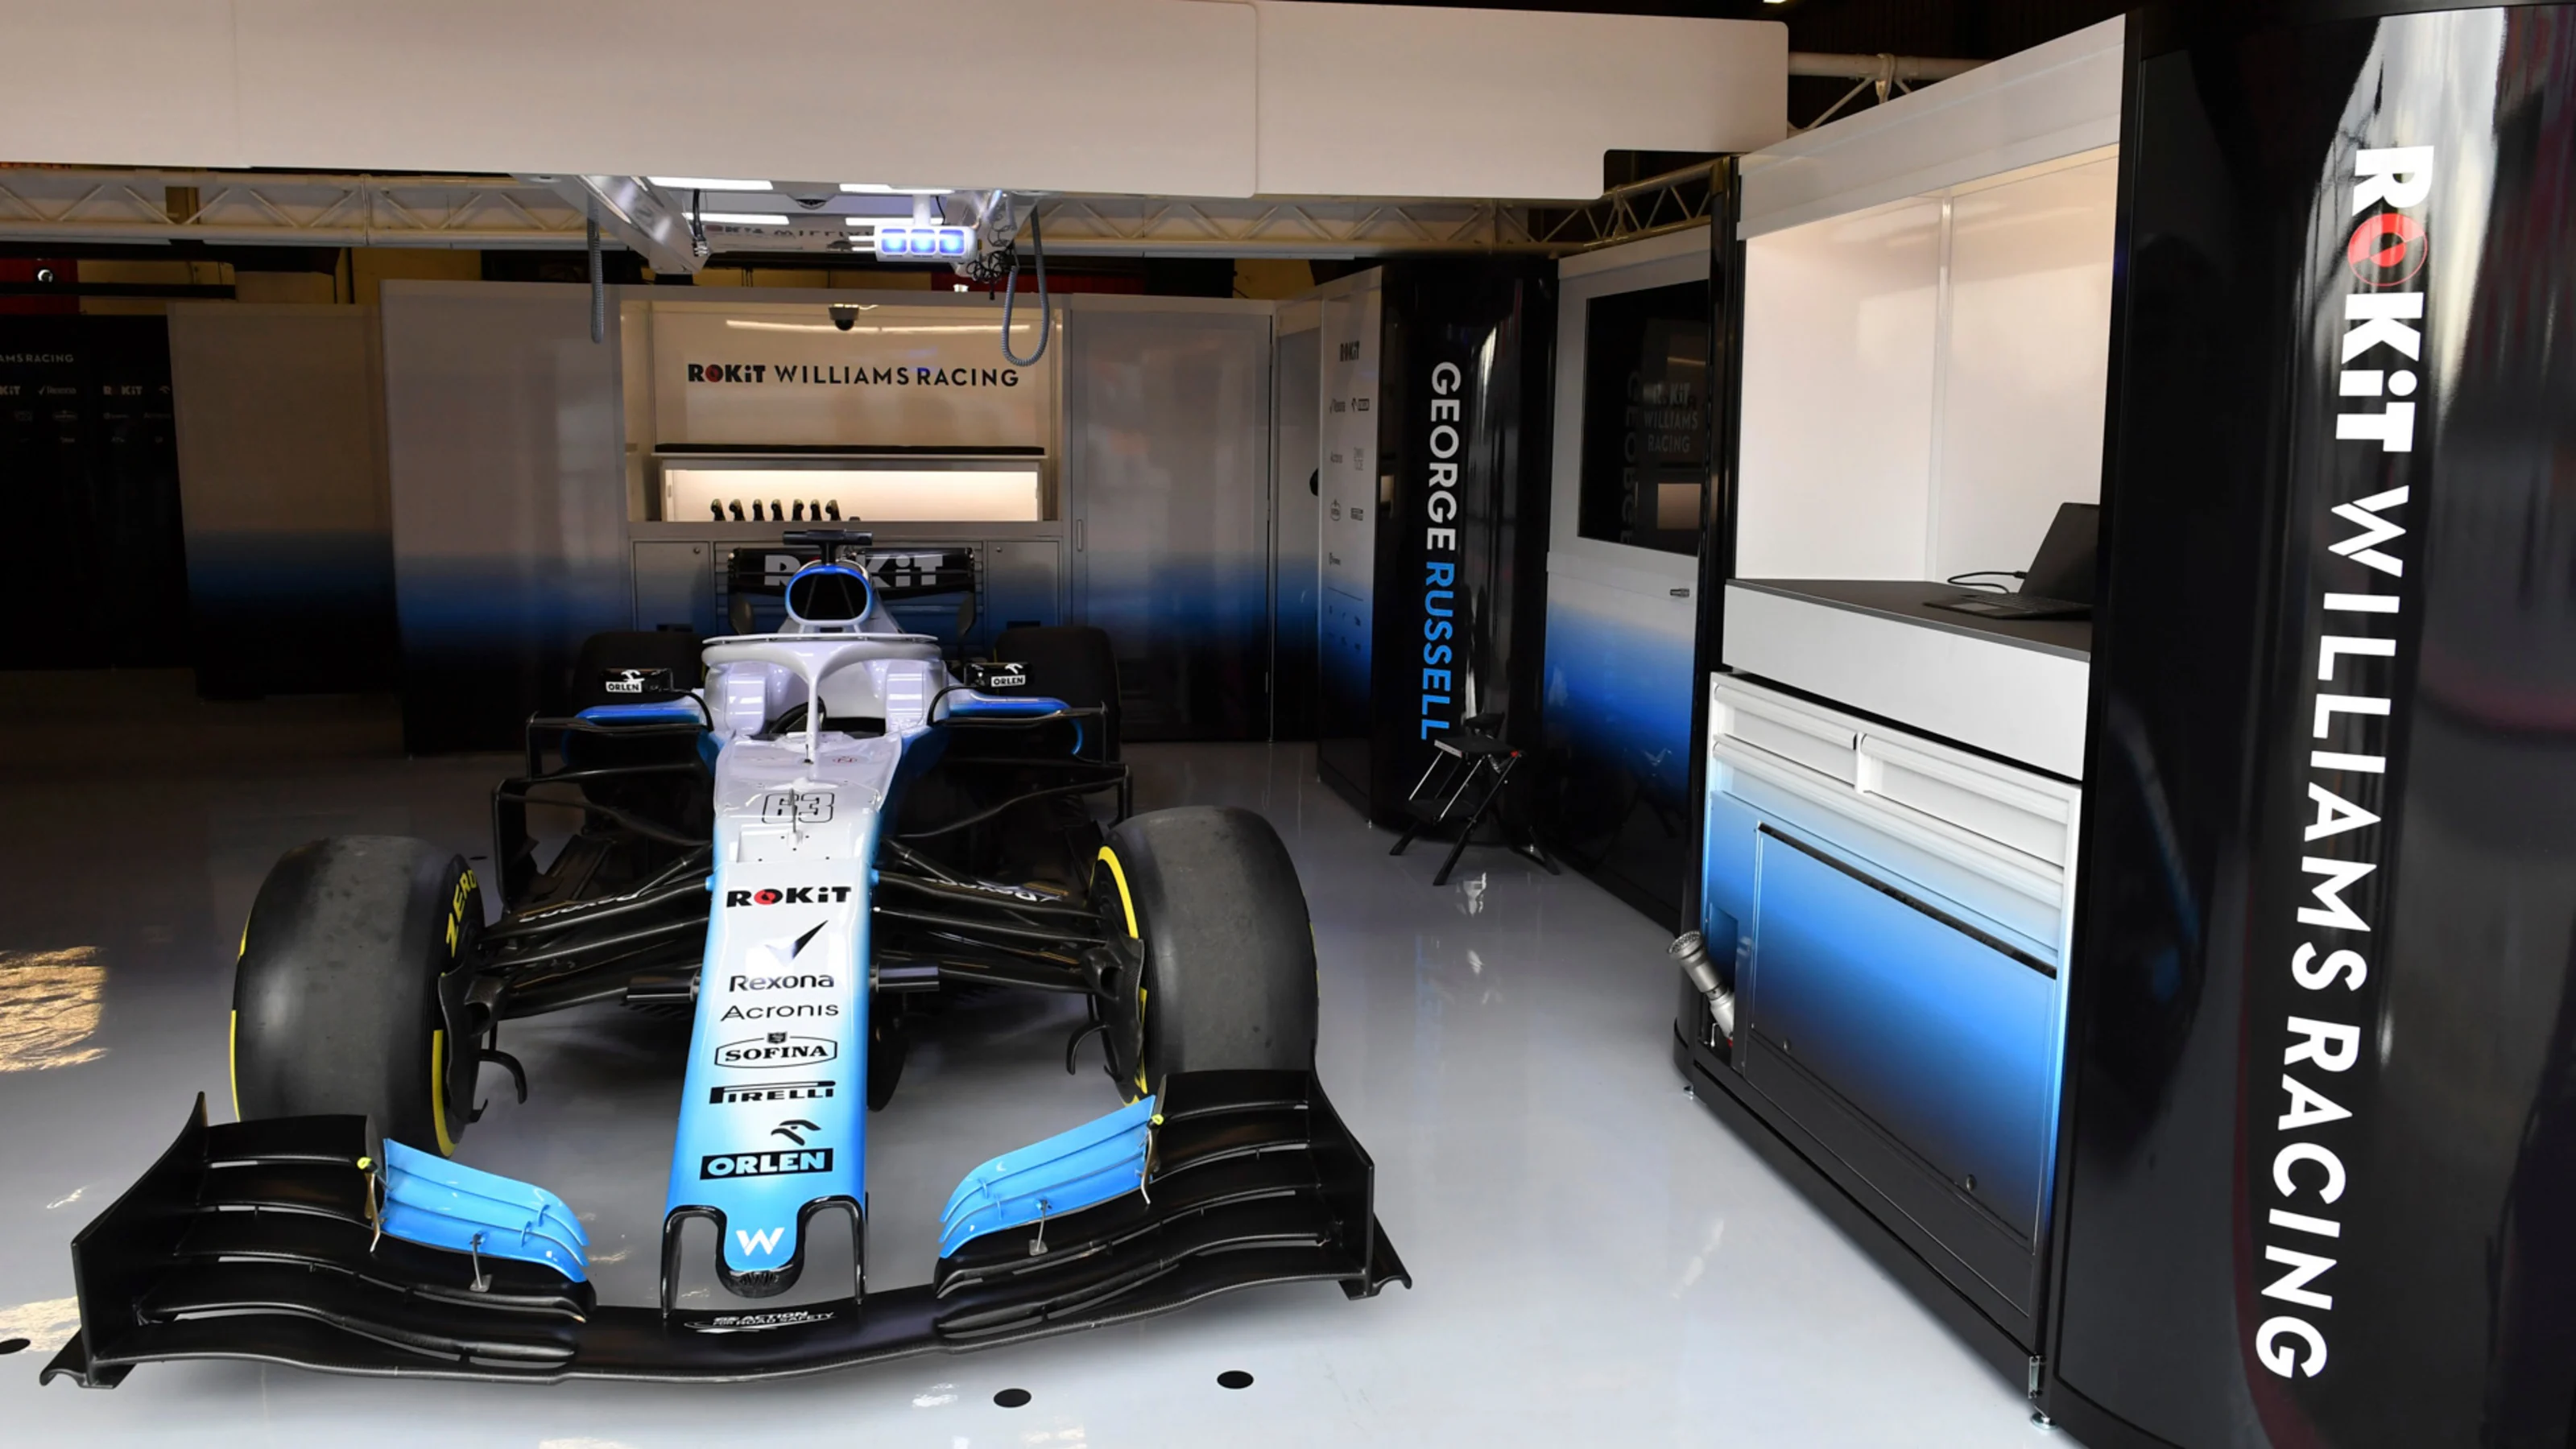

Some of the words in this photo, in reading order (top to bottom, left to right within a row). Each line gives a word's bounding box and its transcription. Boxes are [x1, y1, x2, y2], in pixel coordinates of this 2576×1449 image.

[2336, 145, 2435, 452] ROKiT
[25, 353, 74, 363] RACING
[688, 363, 766, 383] ROKiT
[774, 365, 909, 386] WILLIAMS
[917, 367, 1019, 387] RACING
[102, 385, 143, 396] RKiT
[1644, 410, 1698, 431] WILLIAMS
[1648, 434, 1690, 453] RACING
[1427, 361, 1461, 551] GEORGE
[763, 554, 943, 588] RKiT
[1421, 562, 1454, 740] RUSSELL
[608, 683, 639, 691] ORLEN
[993, 677, 1023, 685] ORLEN
[2292, 485, 2409, 991] WILLIAMS
[762, 792, 835, 824] 63
[726, 886, 852, 908] ROKiT
[729, 975, 835, 993] Rexona
[721, 1004, 839, 1022] Acronis
[726, 1043, 829, 1062] SOFINA
[709, 1080, 837, 1104] PIRELLI
[706, 1152, 826, 1175] ORLEN
[2256, 1016, 2360, 1378] RACING
[735, 1227, 785, 1256] W
